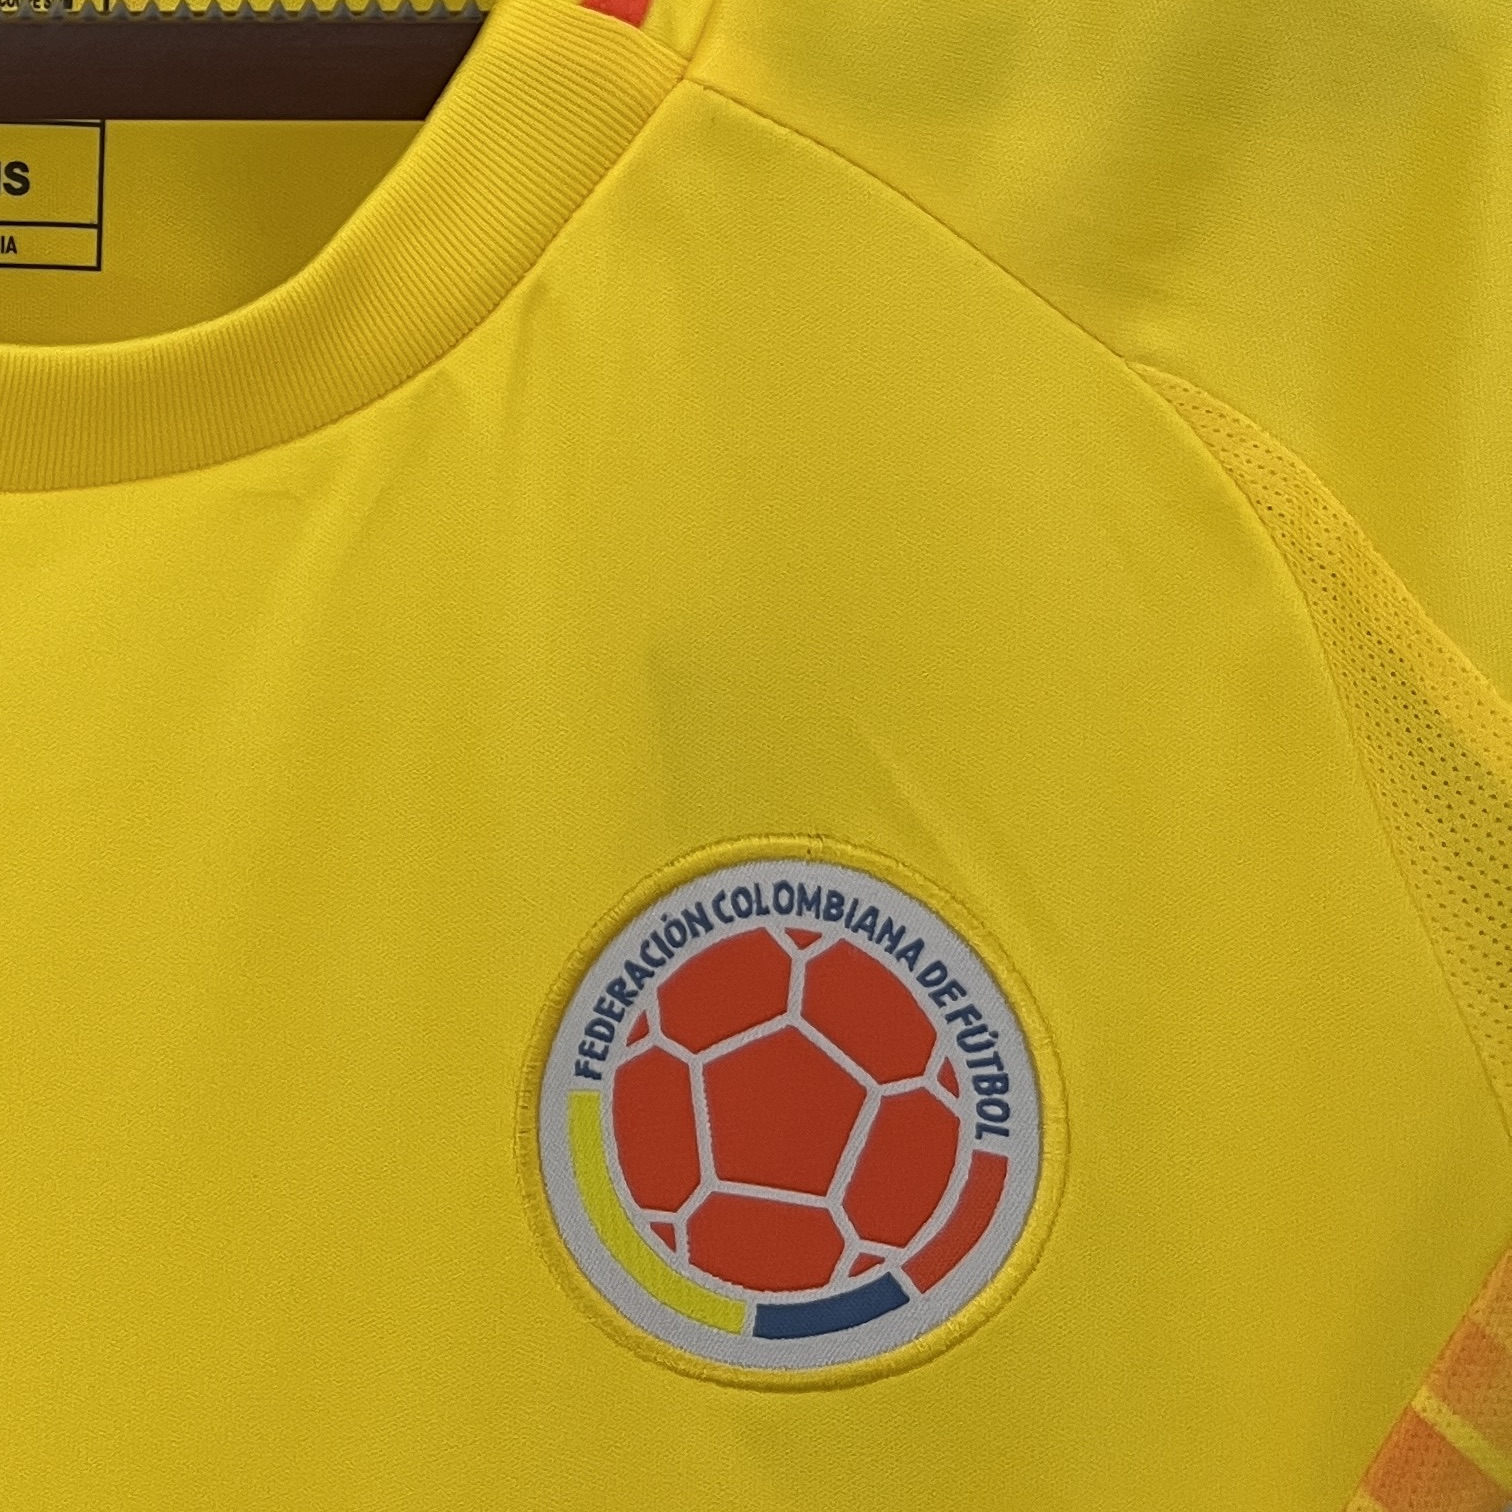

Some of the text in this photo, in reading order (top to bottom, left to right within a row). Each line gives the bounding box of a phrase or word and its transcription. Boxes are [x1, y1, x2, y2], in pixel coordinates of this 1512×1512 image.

[574, 880, 1011, 1141] FEDERACIÓN COLOMBIANA DE FÚTBOL
